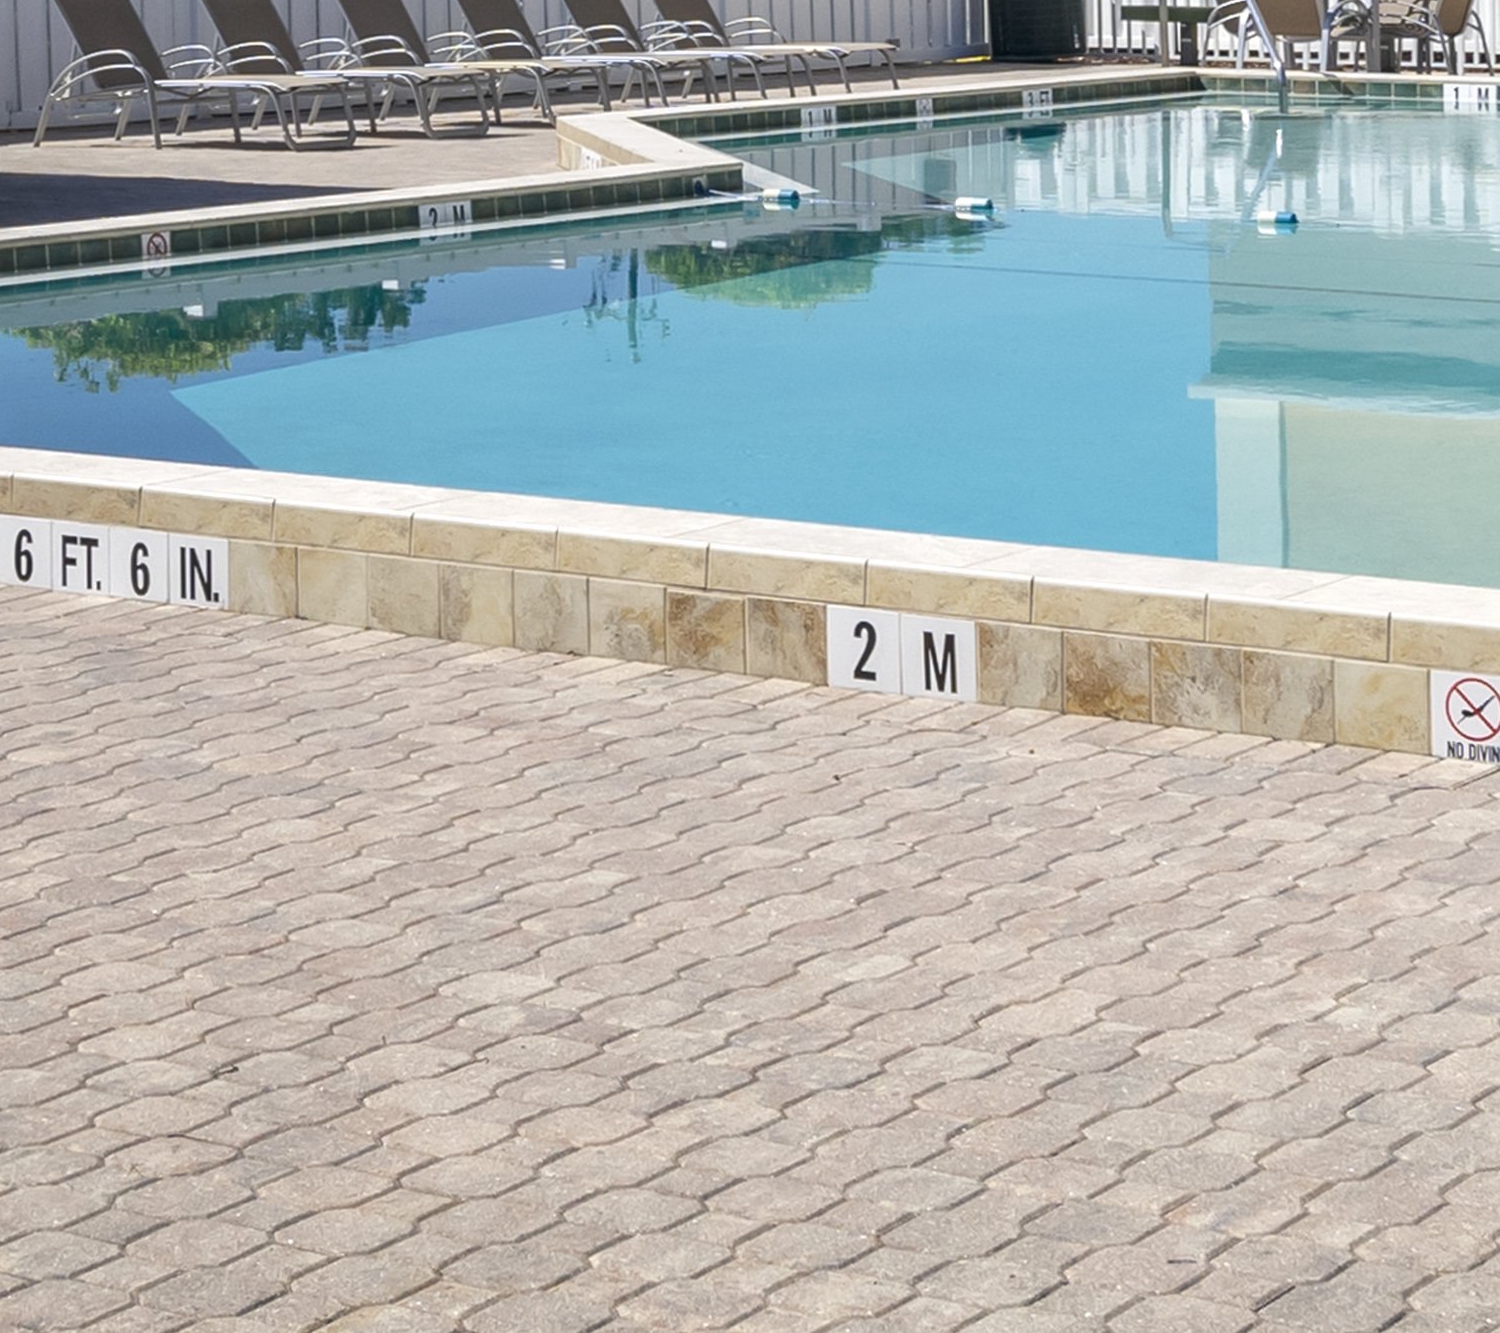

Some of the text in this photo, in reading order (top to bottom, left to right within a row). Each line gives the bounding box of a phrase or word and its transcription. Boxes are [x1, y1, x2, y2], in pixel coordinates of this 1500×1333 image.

[14, 528, 33, 582] 6
[130, 542, 151, 596] 6
[852, 620, 958, 694] 2 M
[1446, 740, 1464, 759] NO
